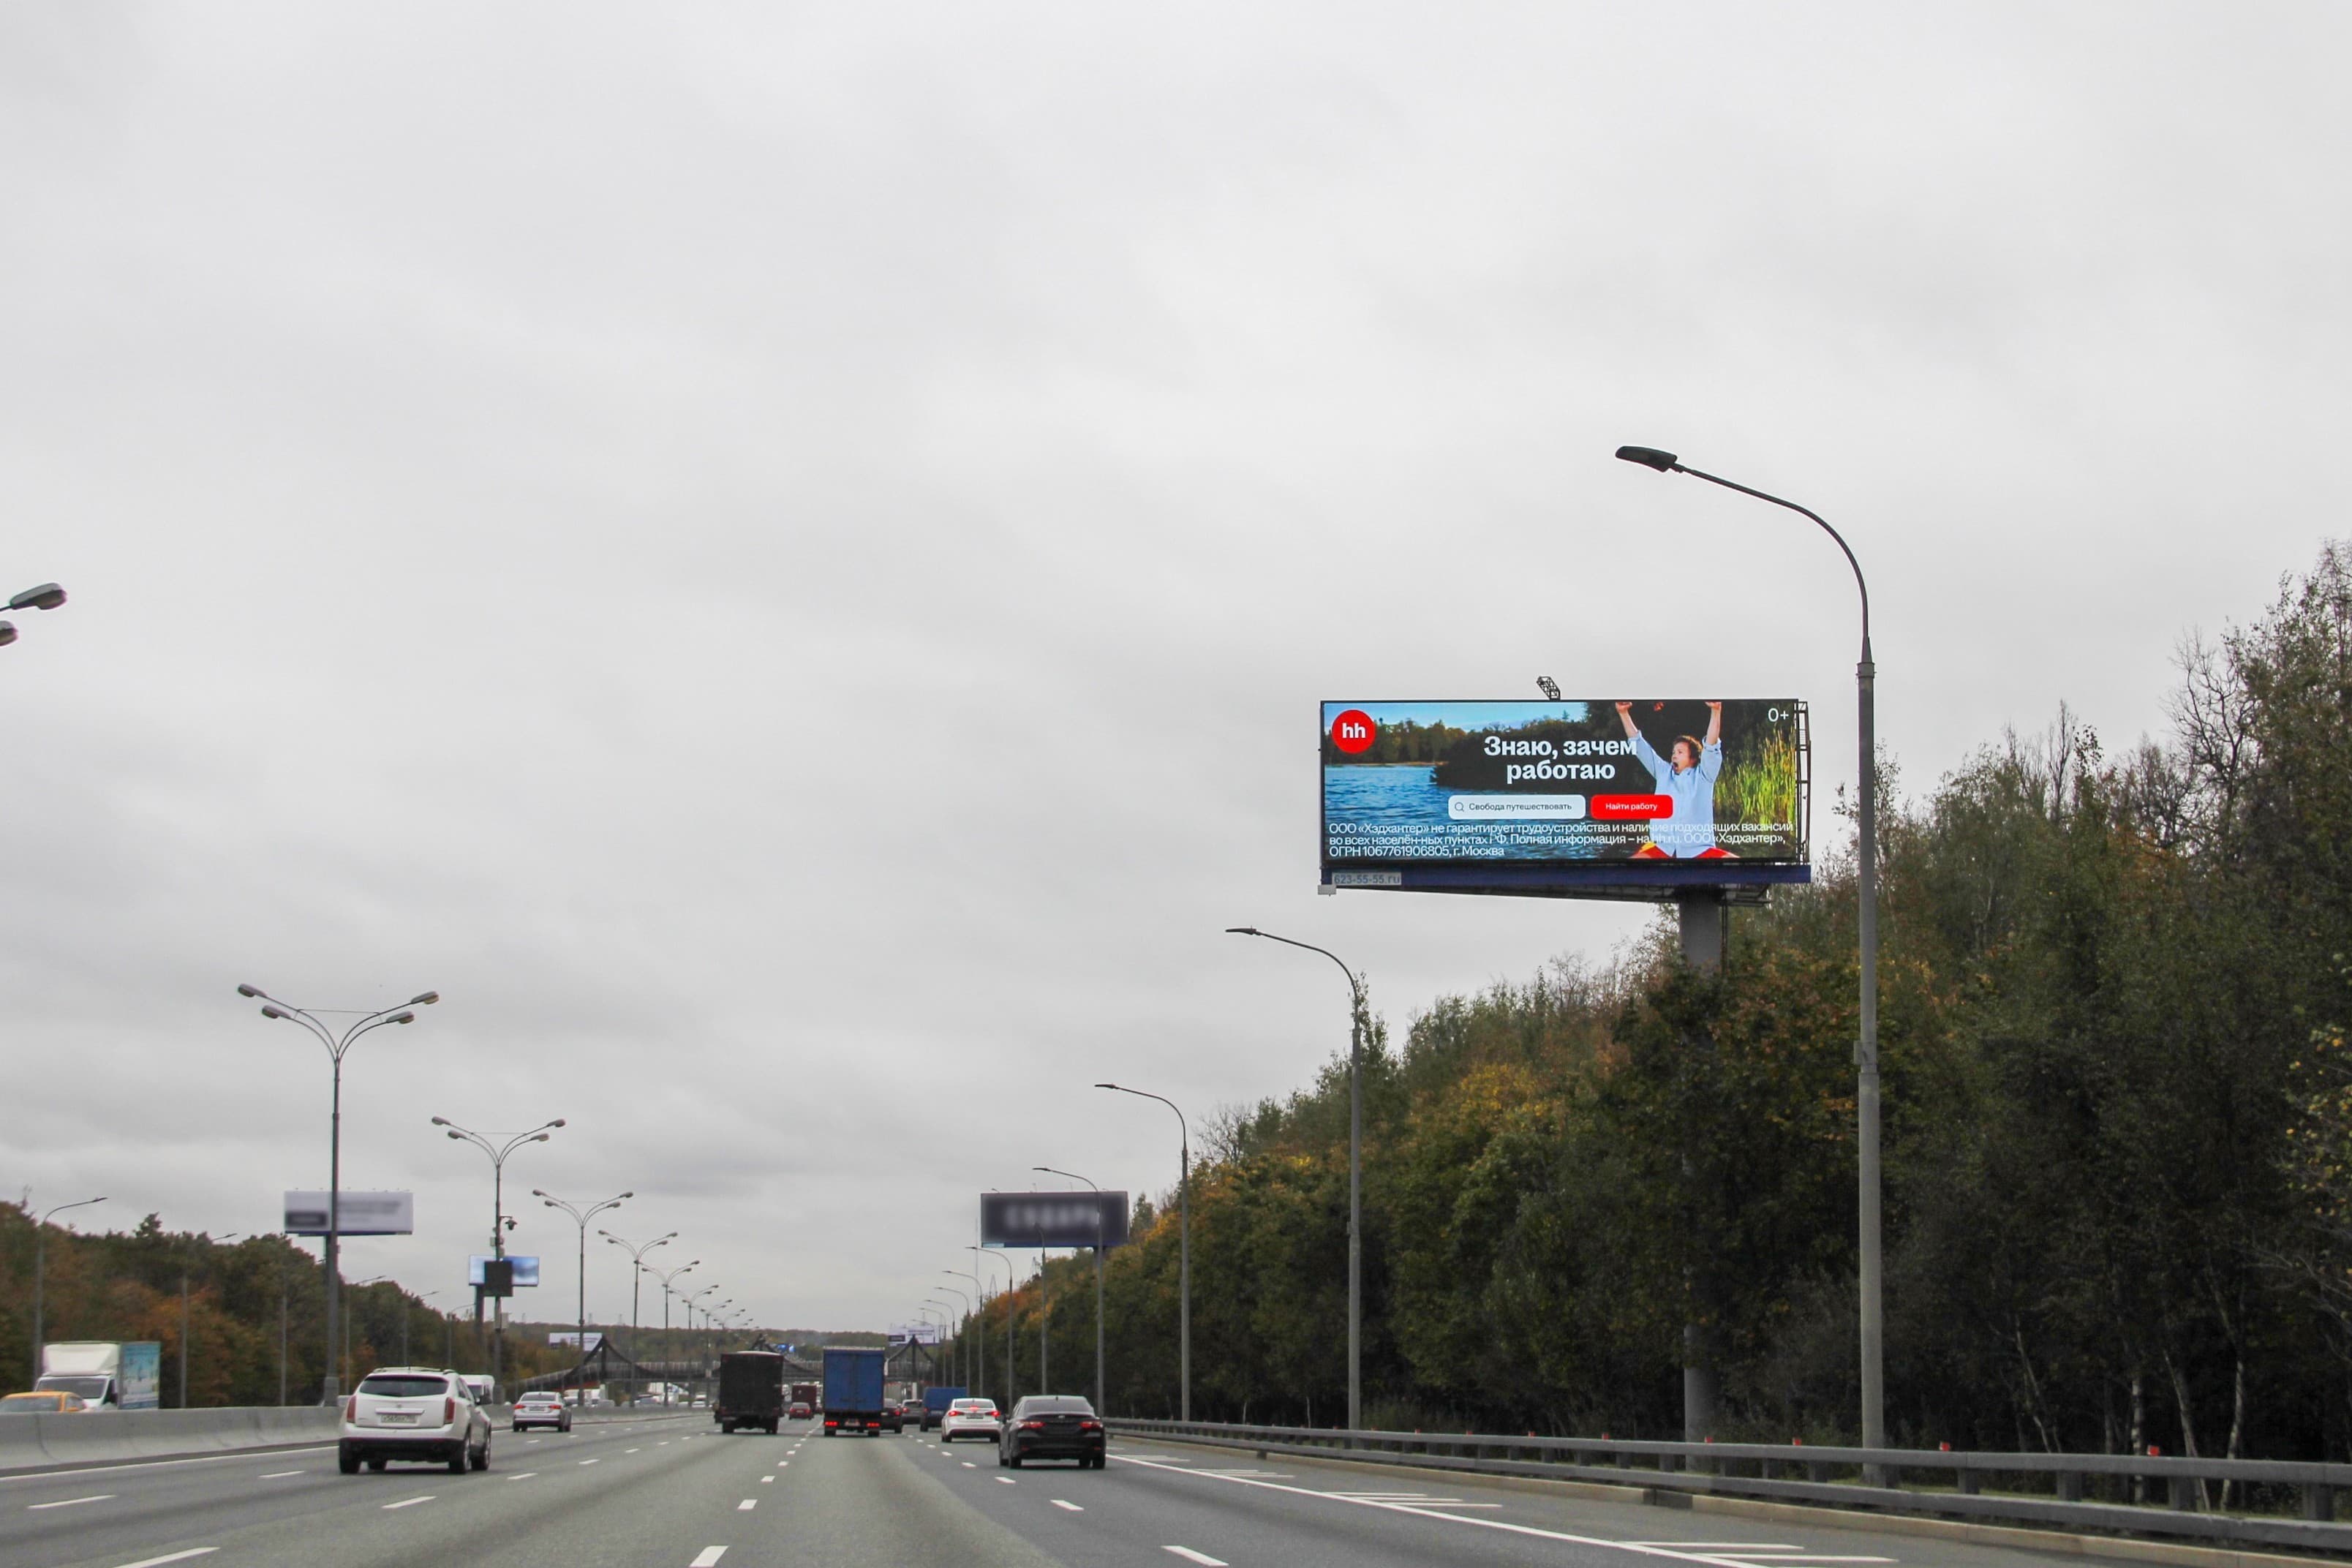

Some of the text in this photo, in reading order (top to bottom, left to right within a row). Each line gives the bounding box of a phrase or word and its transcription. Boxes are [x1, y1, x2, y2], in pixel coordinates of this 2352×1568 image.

[1768, 708, 1789, 723] 0+
[1342, 723, 1366, 739] hh
[1484, 736, 1637, 760] Знаю, зачем
[1507, 761, 1616, 784] работаю
[1469, 802, 1572, 812] Свобода путешествовать
[1605, 802, 1658, 812] Найти работу
[1329, 822, 1793, 835] ООО «Хэдхантер» не гарантирует трудоустройства и наличие подходящих вакансий
[1329, 837, 1343, 845] во
[1344, 837, 1371, 845] всех
[1444, 836, 1488, 847] пунктах
[1490, 834, 1508, 845] РФ.
[1510, 834, 1552, 844] Полная
[1553, 834, 1626, 846] информация
[1637, 835, 1649, 843] на
[1684, 832, 1711, 843] ООО
[1329, 845, 1504, 857] ОГРН 1067761906805, г. Москва
[1333, 874, 1400, 884] 623-55-55.ru
